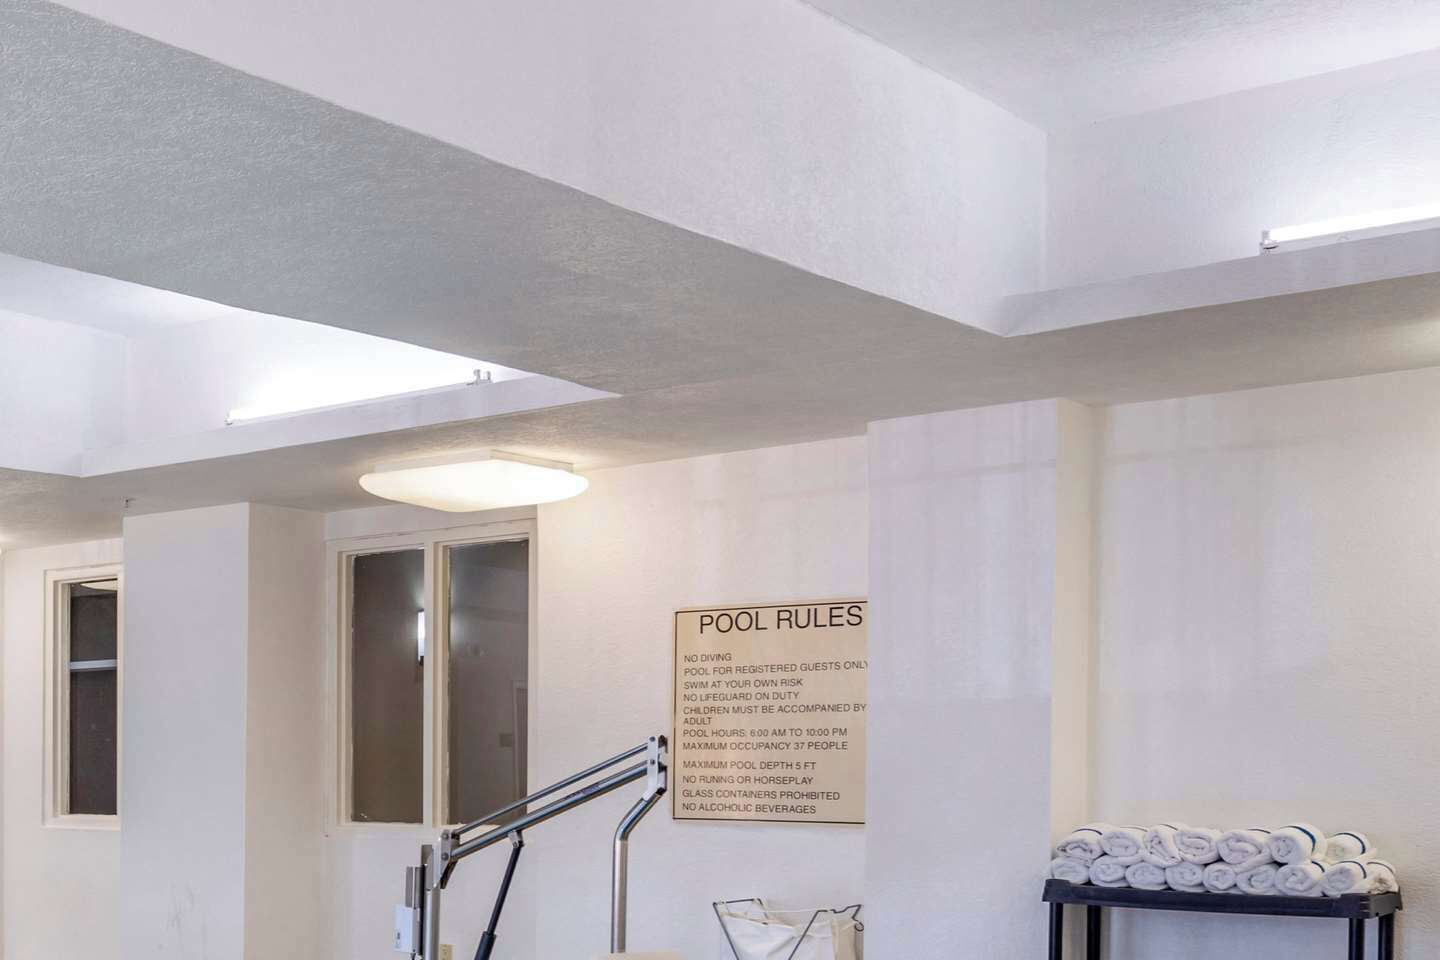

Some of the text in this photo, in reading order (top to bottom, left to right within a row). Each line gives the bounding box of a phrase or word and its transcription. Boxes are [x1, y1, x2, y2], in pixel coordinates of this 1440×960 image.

[700, 606, 863, 634] POOL RULES
[701, 653, 732, 662] DIVING
[684, 667, 710, 676] POOL
[713, 666, 732, 674] FOR
[735, 664, 797, 674] REGISTERED
[800, 662, 841, 671] GUESTS
[684, 681, 709, 689] SWIM
[725, 680, 751, 688] YOUR
[754, 679, 778, 687] OWN
[684, 692, 800, 702] NO LIFEGUARD ON DUTY
[683, 706, 730, 714] CHILDREN
[762, 705, 774, 713] BE
[778, 704, 850, 713] ACCOMPANIED
[854, 704, 867, 712] BY
[684, 717, 712, 725] ADULT
[683, 729, 709, 737] POOL
[789, 728, 802, 736] TO
[806, 728, 829, 736] 10:00
[832, 728, 847, 736] PM
[683, 742, 848, 750] MAXIMUM OCCUPANCY 37 PEOPLE
[683, 761, 816, 770] MAXIMUM POOL DEPTH 5 FT
[737, 776, 751, 784] OR
[754, 777, 813, 785] HORSEPLAY
[683, 790, 840, 800] GLASS CONTAINERS PROHIBITED
[683, 803, 816, 814] NO ALCOHOLIC BEVERAGES
